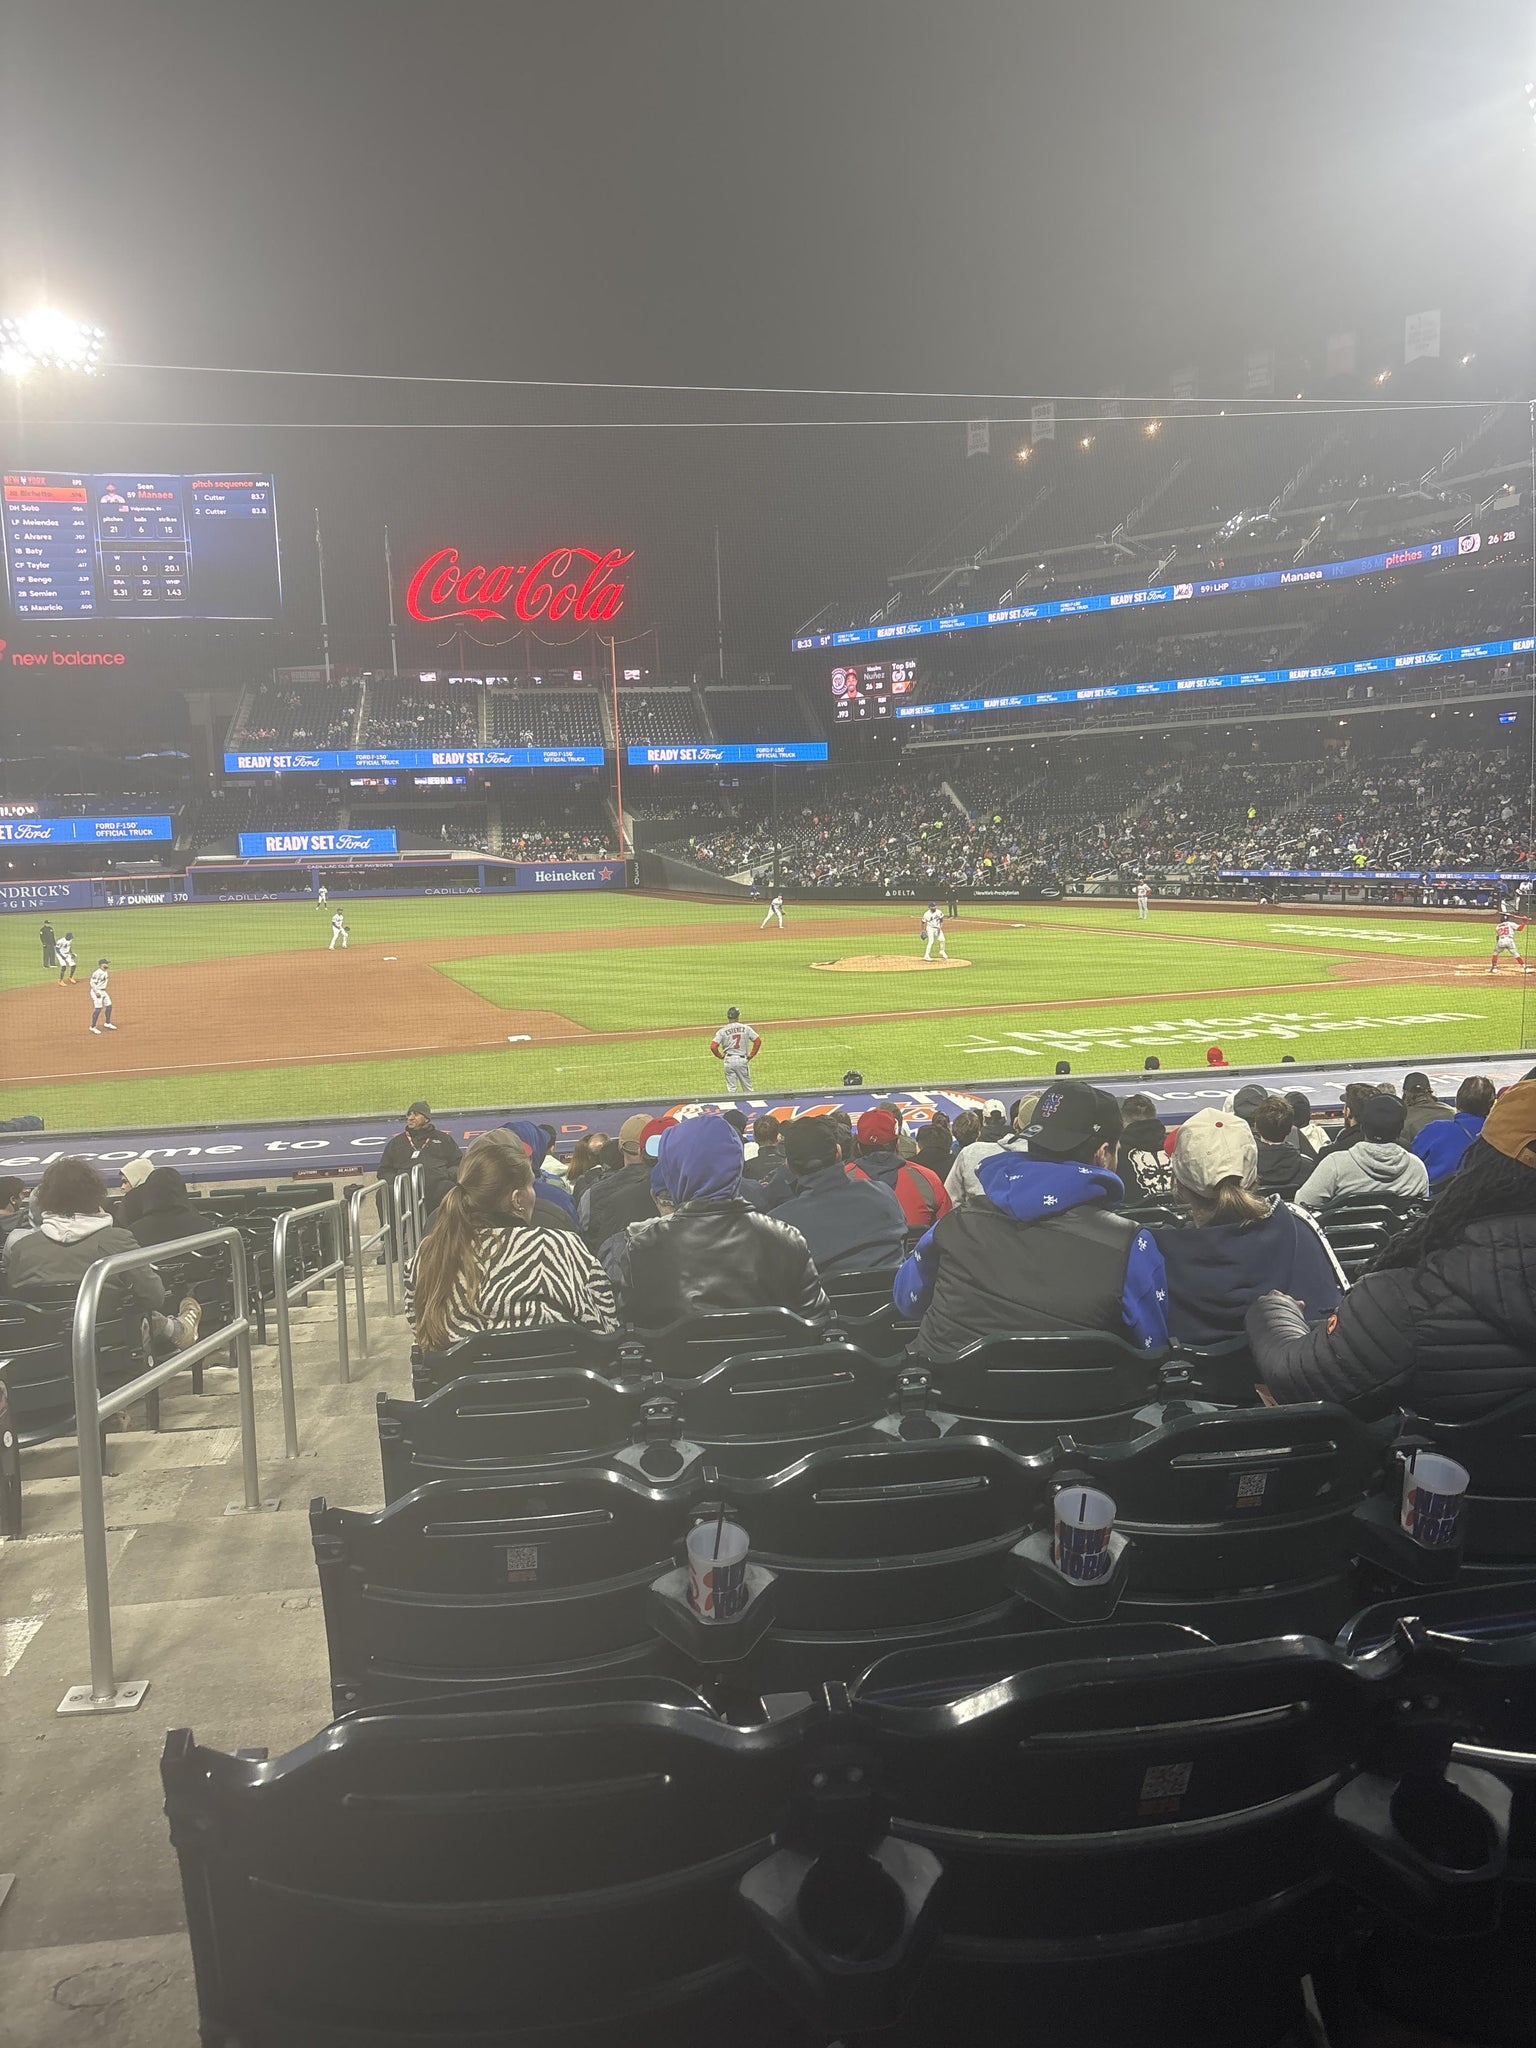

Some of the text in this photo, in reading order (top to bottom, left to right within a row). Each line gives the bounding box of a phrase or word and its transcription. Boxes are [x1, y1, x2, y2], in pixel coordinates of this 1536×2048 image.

[191, 480, 253, 489] pitch sequence
[138, 490, 174, 499] Manaea
[22, 518, 59, 526] Melendez
[1488, 531, 1516, 545] 26 2B
[25, 548, 43, 556] Baty
[1385, 544, 1442, 568] pitches 21
[26, 562, 50, 570] Taylor
[28, 576, 52, 584] Benge
[1280, 569, 1323, 584] Manaea
[406, 548, 635, 622] Coca-Cola
[1200, 585, 1210, 593] 59
[1214, 583, 1229, 592] LHP
[113, 588, 128, 596] 5.31
[1110, 594, 1134, 606] READY
[1134, 592, 1147, 603] SET
[1147, 590, 1167, 601] Ford
[31, 604, 63, 612] Mauricio
[987, 608, 1039, 623] READY SET Ford
[876, 627, 895, 638] READY
[895, 625, 906, 636] SET
[797, 639, 812, 648] 8:33
[1513, 639, 1535, 651] READY
[12, 651, 126, 665] new balance
[1395, 656, 1414, 667] READY
[1414, 655, 1426, 665] SET
[892, 663, 904, 671] Top
[908, 671, 914, 679] 9
[1289, 669, 1310, 679] READY
[1310, 668, 1322, 678] SET
[1177, 680, 1196, 690] READY
[1196, 679, 1207, 688] SET
[1077, 690, 1095, 699] READY
[1095, 689, 1104, 698] SET
[432, 752, 512, 765] READY SET Ford
[647, 749, 724, 761] READY SET Ford
[238, 755, 320, 769] READY SET Ford
[14, 824, 52, 839] Ford
[95, 828, 153, 837] OFFICIAL TRUCK
[266, 835, 372, 851] READY SET Ford
[535, 869, 595, 882] Heineken
[424, 887, 482, 895] CADILLAC
[128, 894, 165, 905] DUNKIN'
[173, 893, 188, 902] 370
[218, 893, 278, 902] CADILLAC
[10, 900, 38, 908] GIN
[1497, 927, 1509, 936] 26
[1043, 1012, 1488, 1052] Presbyterian
[732, 1034, 741, 1049] 7
[264, 1138, 330, 1151] to
